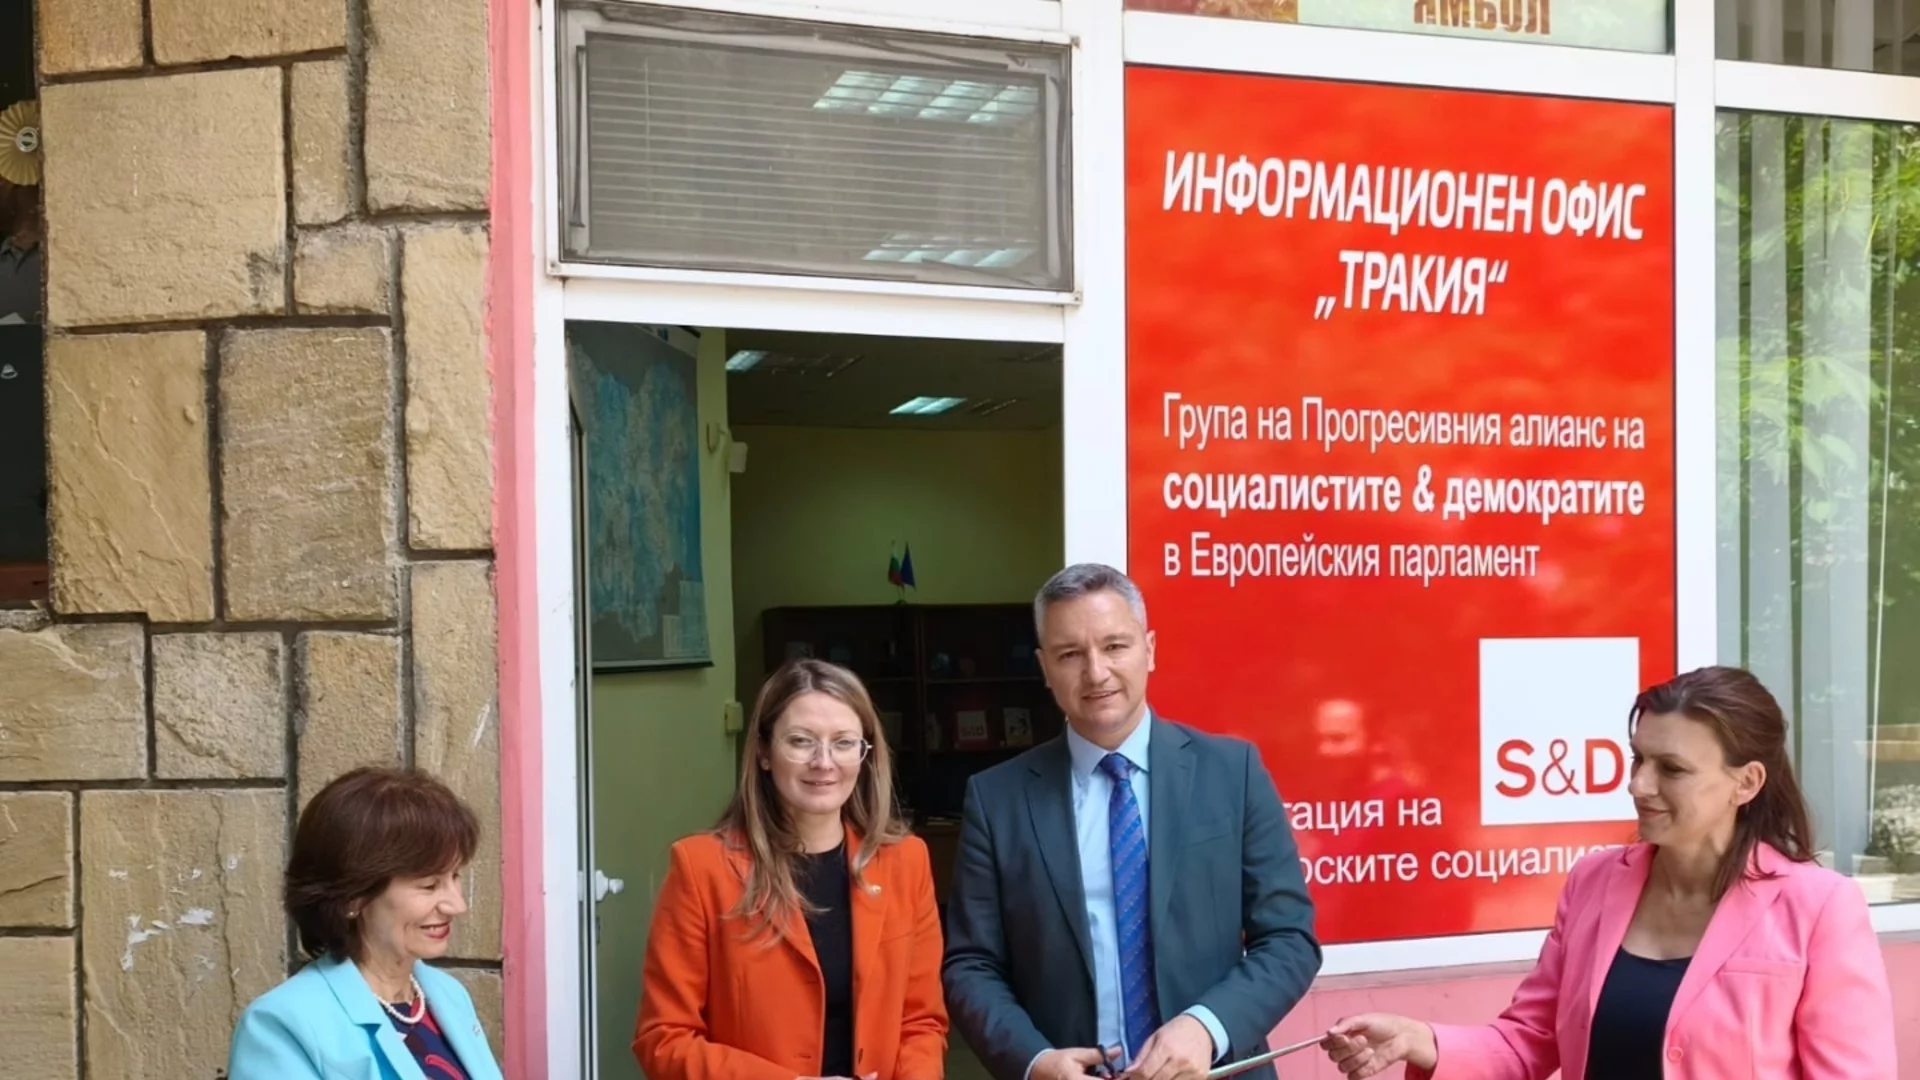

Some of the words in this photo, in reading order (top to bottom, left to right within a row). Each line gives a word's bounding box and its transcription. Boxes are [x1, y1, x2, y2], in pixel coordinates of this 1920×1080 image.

[1162, 150, 1534, 235] ИНФОРМАЦИОНЕН
[1541, 178, 1647, 240] ОФИС
[1313, 250, 1509, 320] „ТРАКИЯ“
[1163, 392, 1248, 450] Група
[1258, 406, 1293, 440] на
[1302, 397, 1502, 452] Прогресивния
[1509, 414, 1606, 448] алианс
[1613, 416, 1645, 449] на
[1163, 472, 1401, 517] социалистите
[1412, 464, 1436, 513] &
[1443, 477, 1645, 525] демократите
[1165, 543, 1181, 576] в
[1191, 532, 1380, 587] Европейския
[1390, 544, 1540, 587] парламент
[1495, 738, 1625, 798] S&D
[1398, 798, 1442, 826] на
